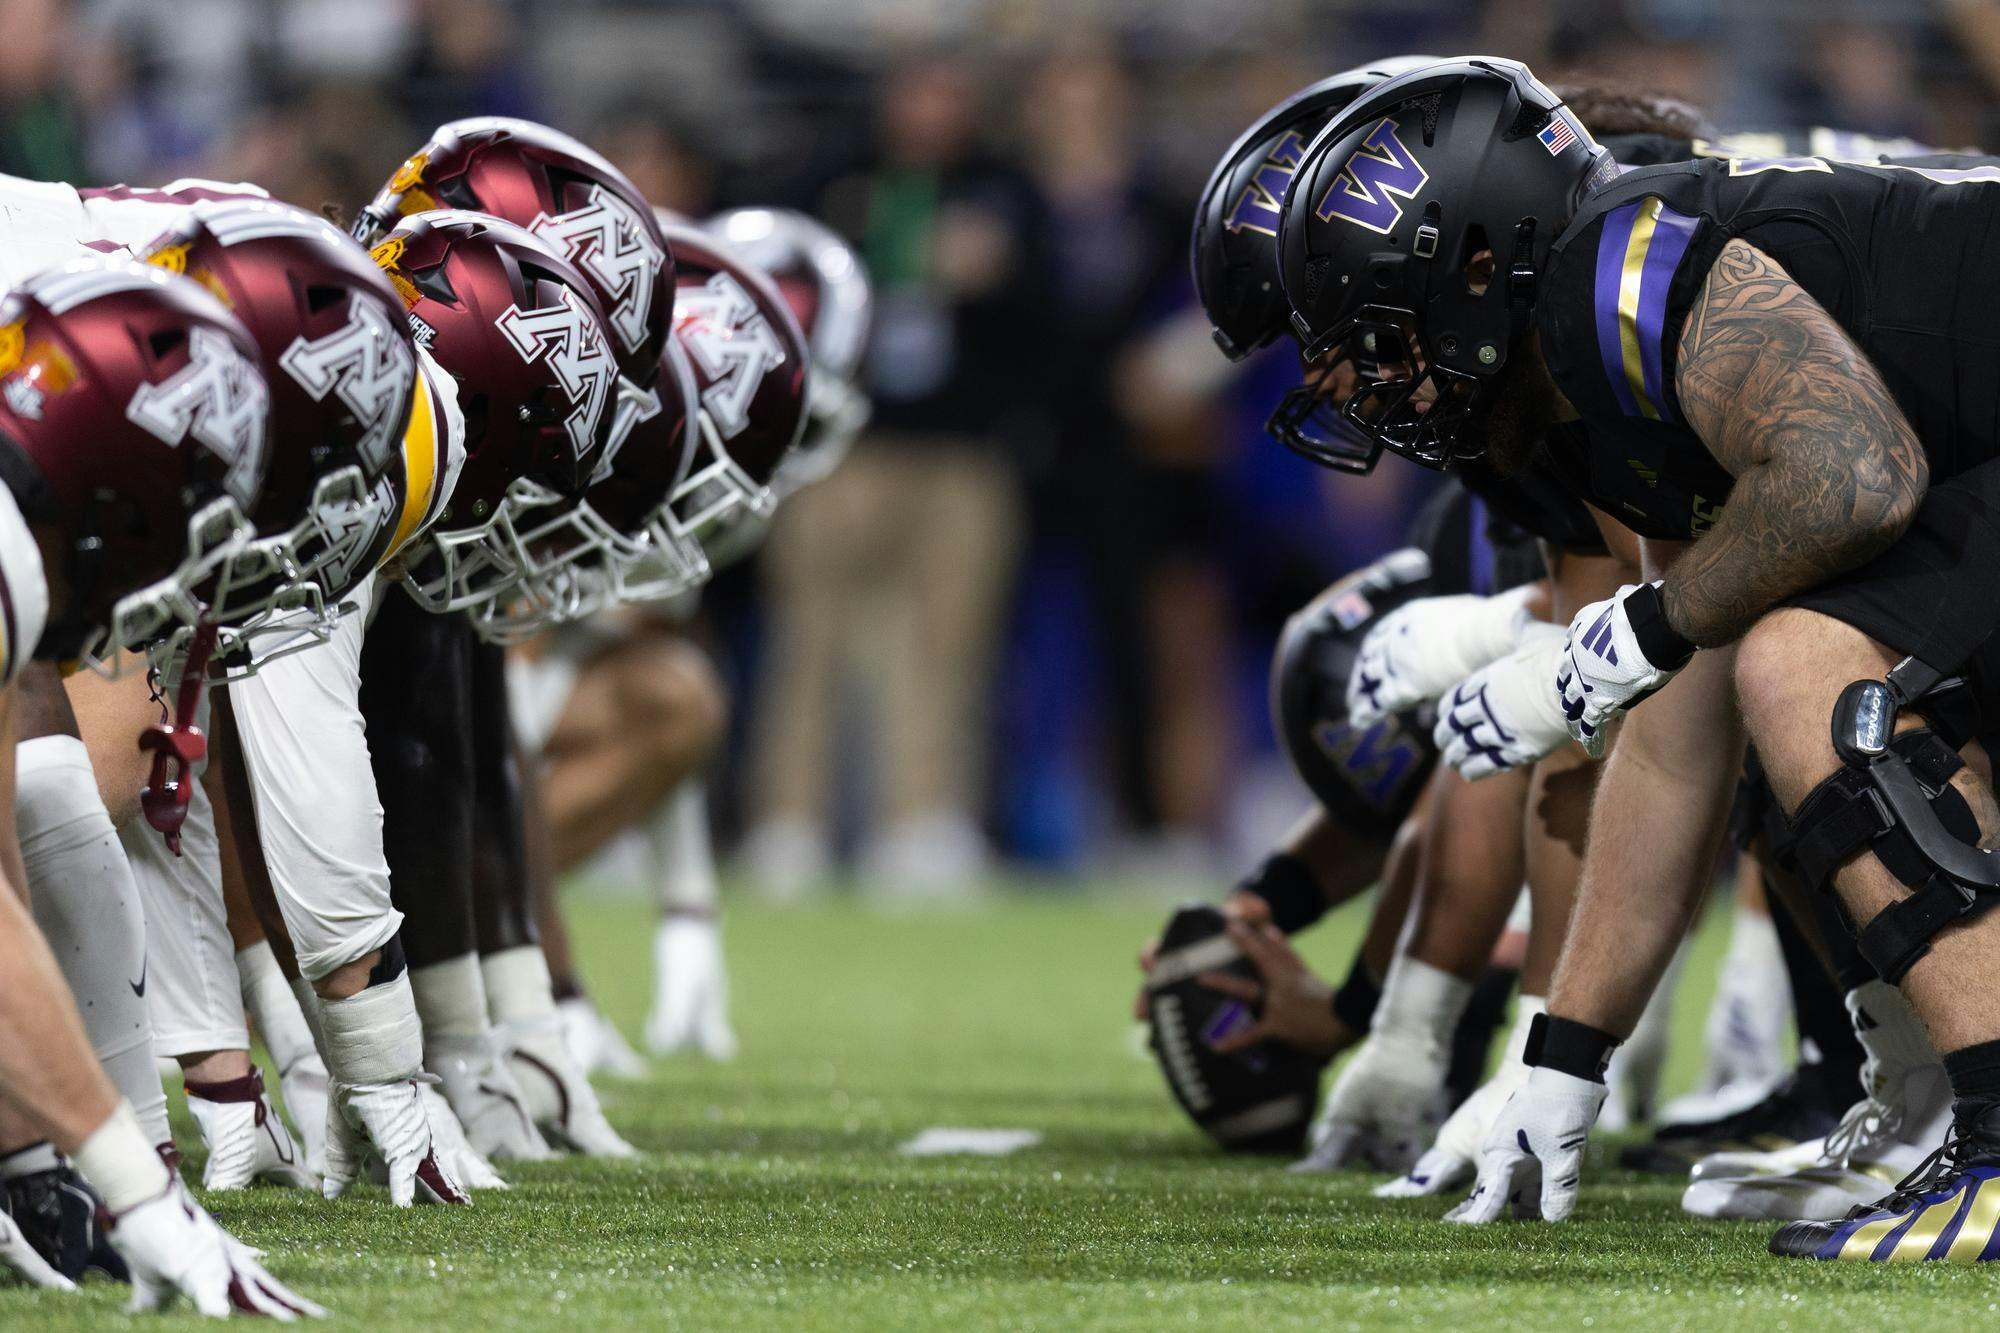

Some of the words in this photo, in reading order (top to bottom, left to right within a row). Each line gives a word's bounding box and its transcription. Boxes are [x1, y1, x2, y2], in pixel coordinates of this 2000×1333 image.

[1316, 117, 1430, 235] W
[527, 184, 666, 354] M
[674, 272, 785, 440] M
[126, 325, 269, 511] M
[279, 289, 416, 476] M
[495, 283, 619, 461] M
